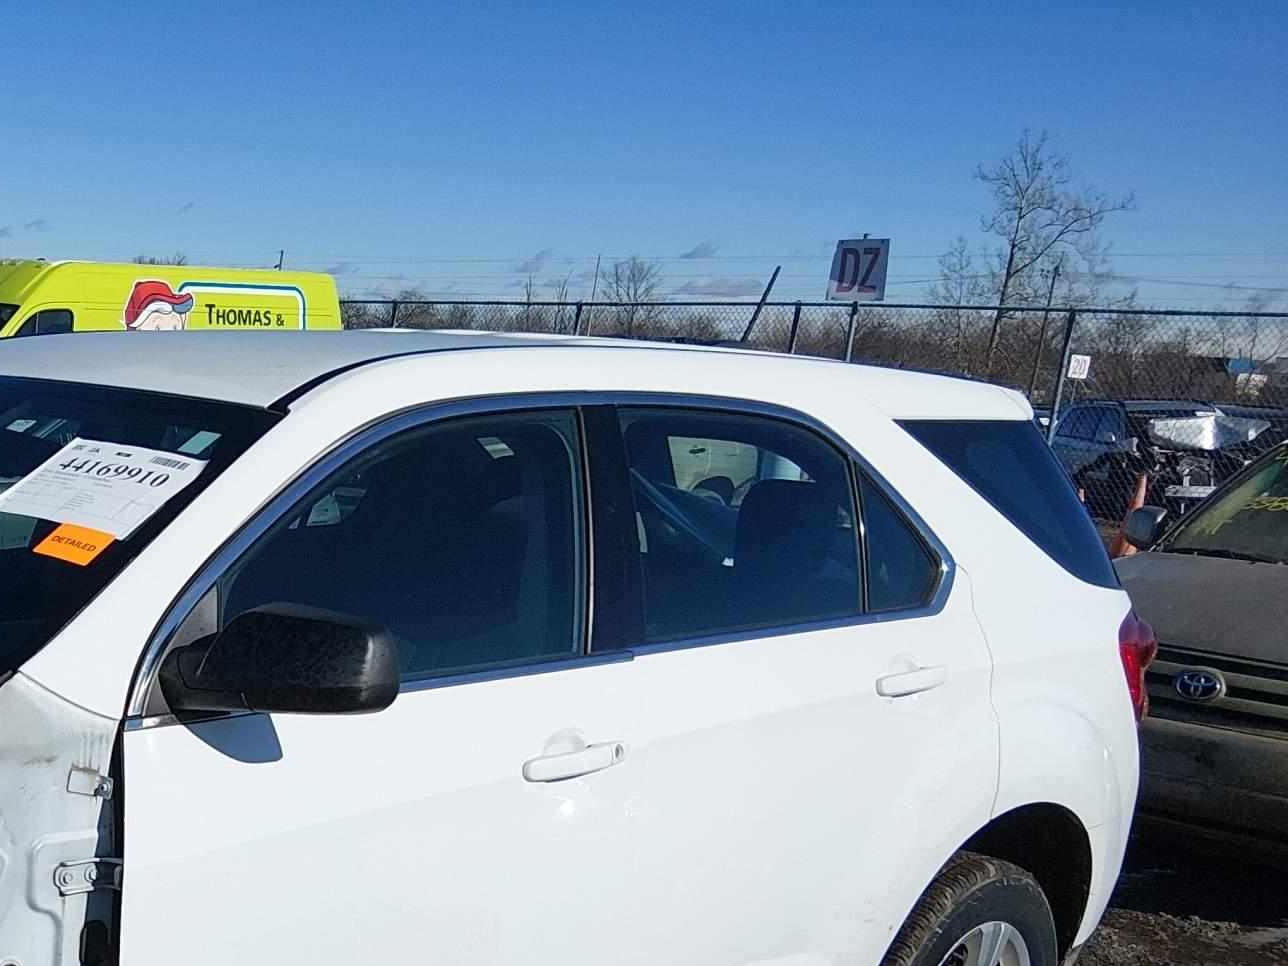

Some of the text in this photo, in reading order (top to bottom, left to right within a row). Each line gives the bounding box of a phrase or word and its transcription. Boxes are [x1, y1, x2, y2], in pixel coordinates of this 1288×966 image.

[835, 247, 881, 293] DZ
[204, 303, 285, 327] THOMAS &
[60, 457, 170, 487] 44169910
[50, 535, 97, 552] DETAILED
